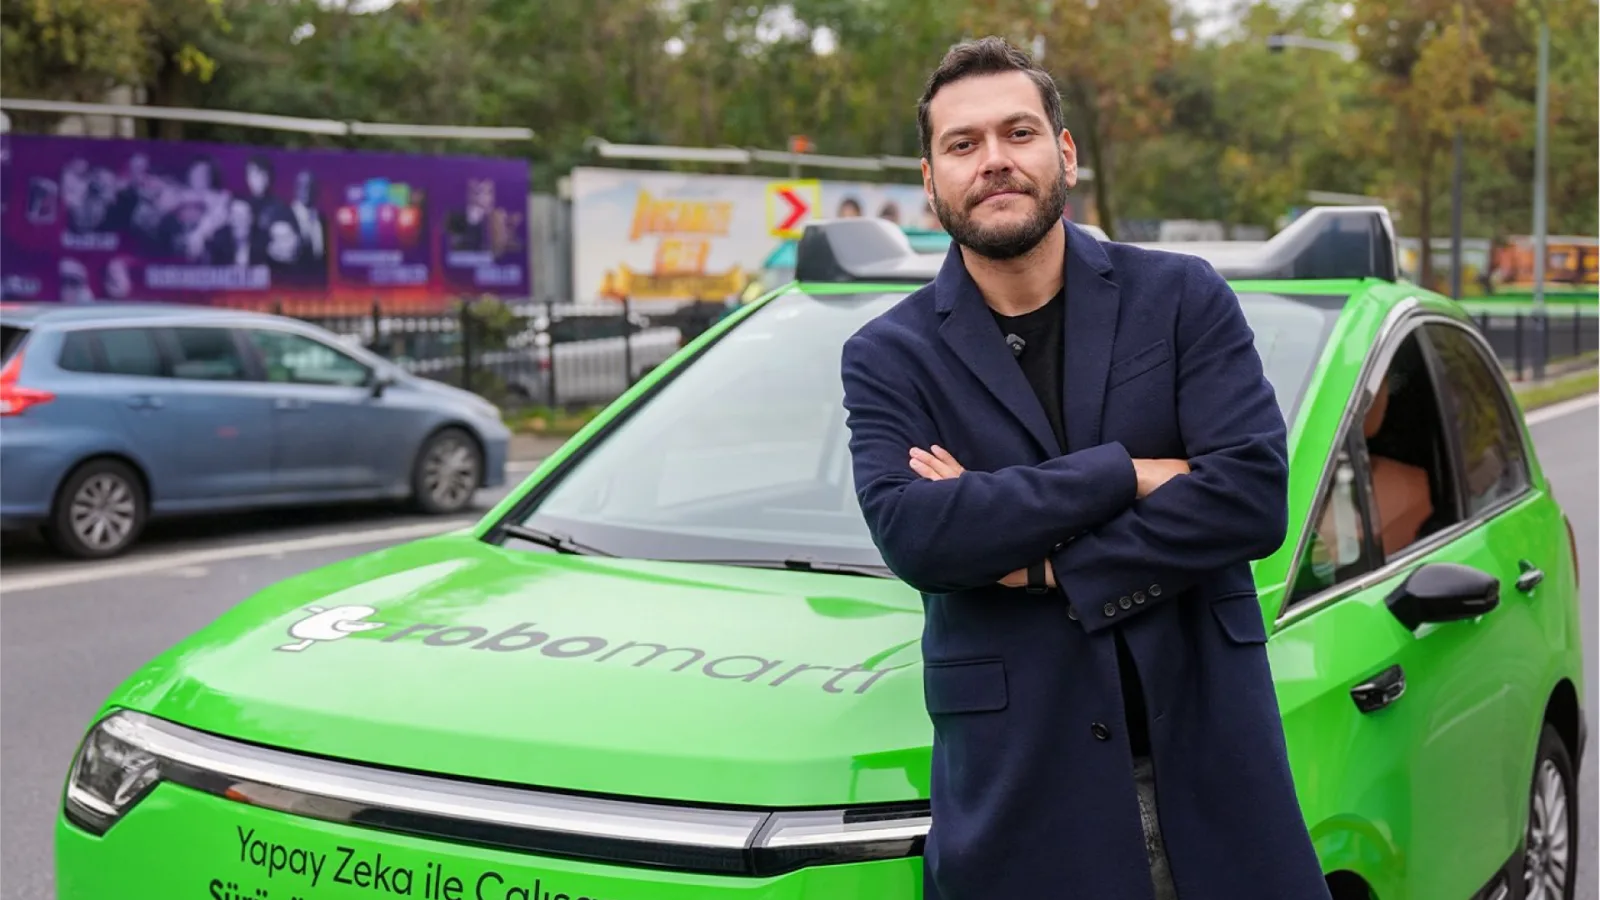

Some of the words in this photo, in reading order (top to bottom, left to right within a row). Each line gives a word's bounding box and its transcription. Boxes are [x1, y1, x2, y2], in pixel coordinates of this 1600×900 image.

[236, 825, 327, 887] Yapay
[333, 846, 414, 896] Zeka
[425, 861, 464, 900] ile
